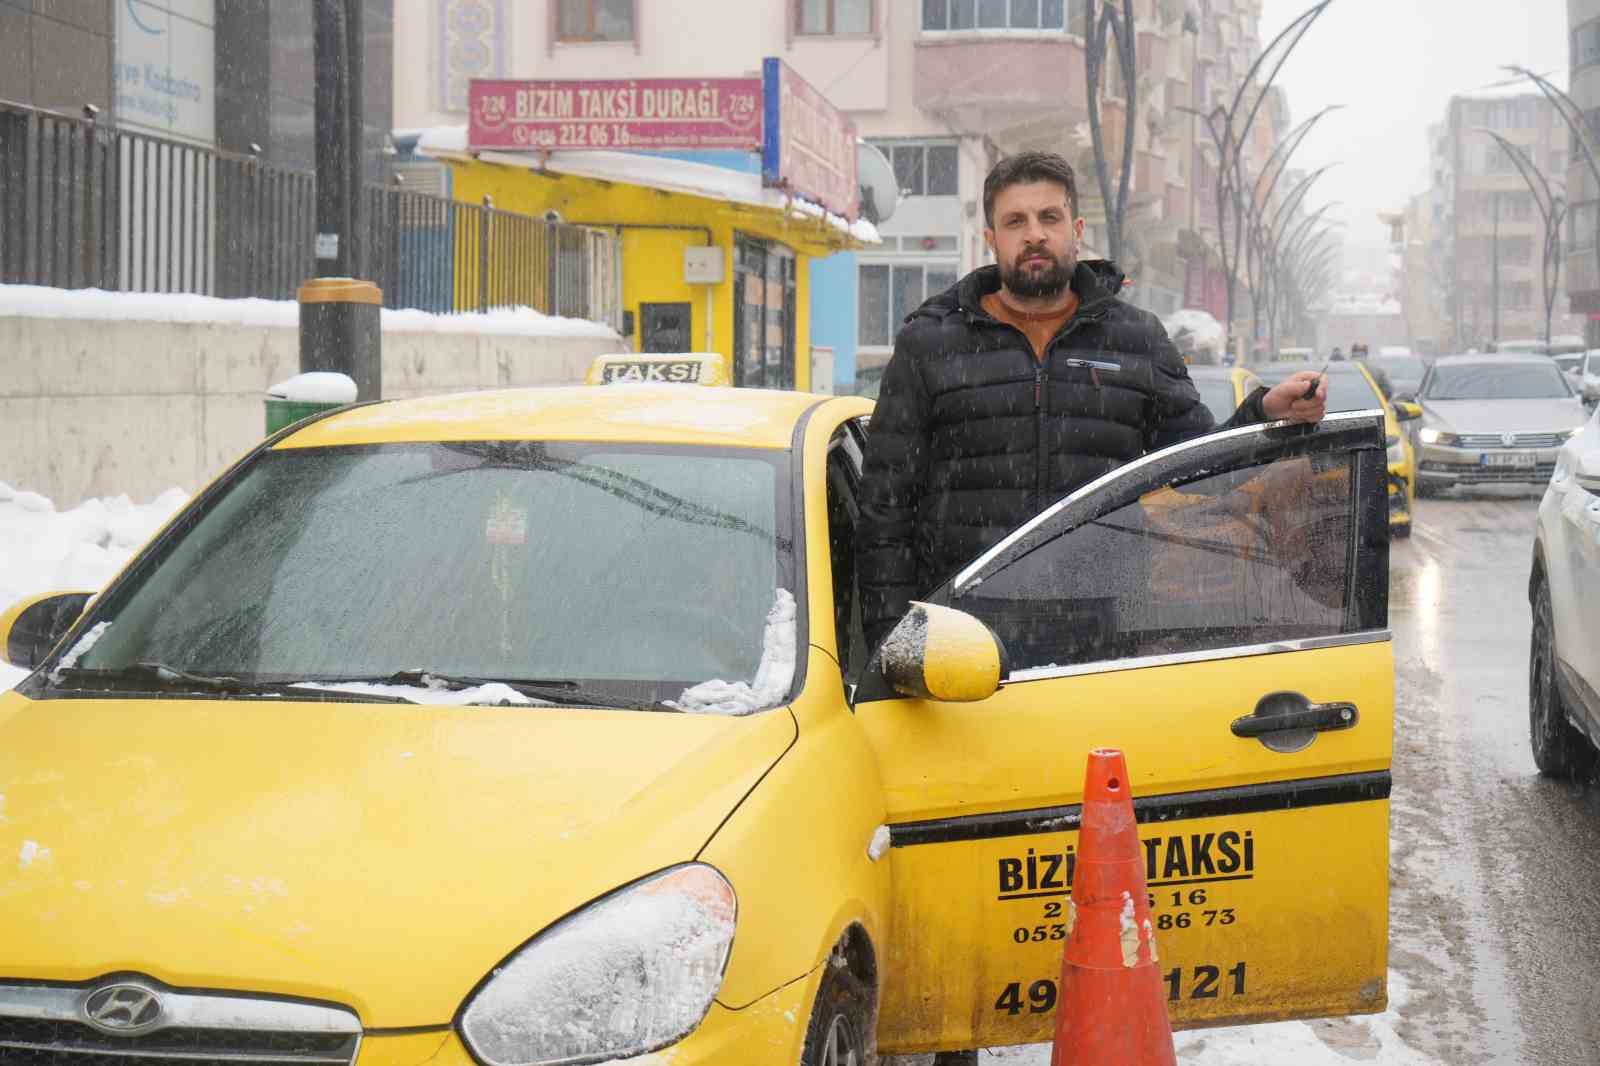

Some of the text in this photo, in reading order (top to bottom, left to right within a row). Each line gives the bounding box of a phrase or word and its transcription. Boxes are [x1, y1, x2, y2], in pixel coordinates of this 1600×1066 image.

[516, 80, 719, 118] BİZİM TAKSİ DURAĞI
[729, 94, 755, 113] 7/24
[560, 124, 587, 146] 212
[591, 124, 609, 146] 06
[613, 124, 630, 145] 16
[998, 846, 1075, 893] BİZİ
[1171, 889, 1208, 906] 16
[1157, 912, 1191, 930] 86
[1202, 908, 1236, 926] 73
[995, 980, 1058, 1016] 49
